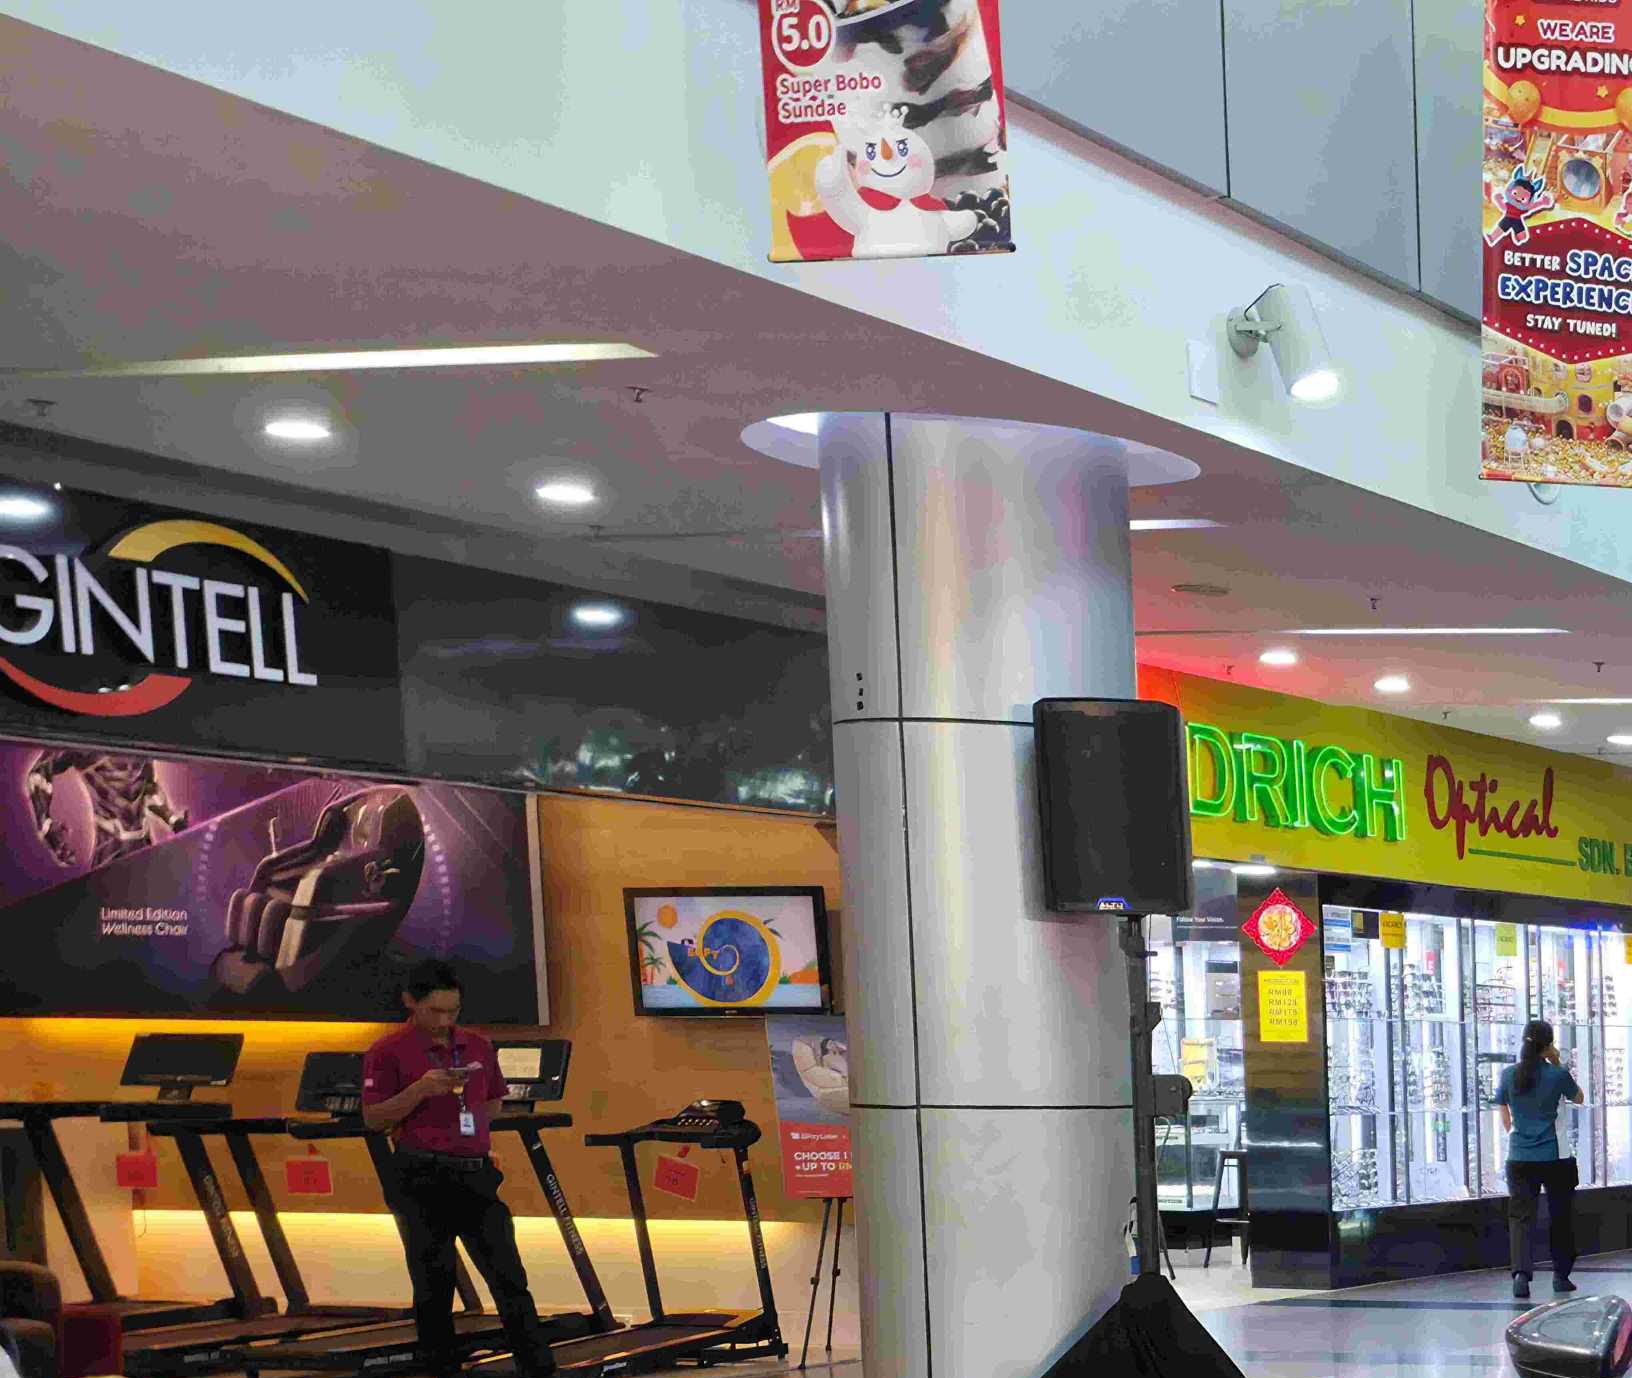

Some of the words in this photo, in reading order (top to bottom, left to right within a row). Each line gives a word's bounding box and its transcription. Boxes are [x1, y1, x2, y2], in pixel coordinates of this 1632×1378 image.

[781, 14, 830, 52] 5.0
[1539, 20, 1571, 39] WE
[1573, 22, 1615, 42] ARE
[780, 77, 831, 97] Super
[835, 72, 882, 91] Bobo
[781, 100, 847, 119] Sundae
[1503, 250, 1561, 272] BETTER
[1526, 314, 1562, 331] STAY
[1566, 319, 1617, 338] TUNED!
[0, 552, 318, 687] GINTELL
[1424, 754, 1559, 860] Optical
[1577, 835, 1620, 875] SDN.
[101, 907, 144, 921] Limited
[147, 906, 188, 921] Edition
[101, 922, 152, 936] Wellness
[154, 921, 188, 936] Chair
[793, 1151, 841, 1161] CHOOSE
[820, 1161, 836, 1171] TO
